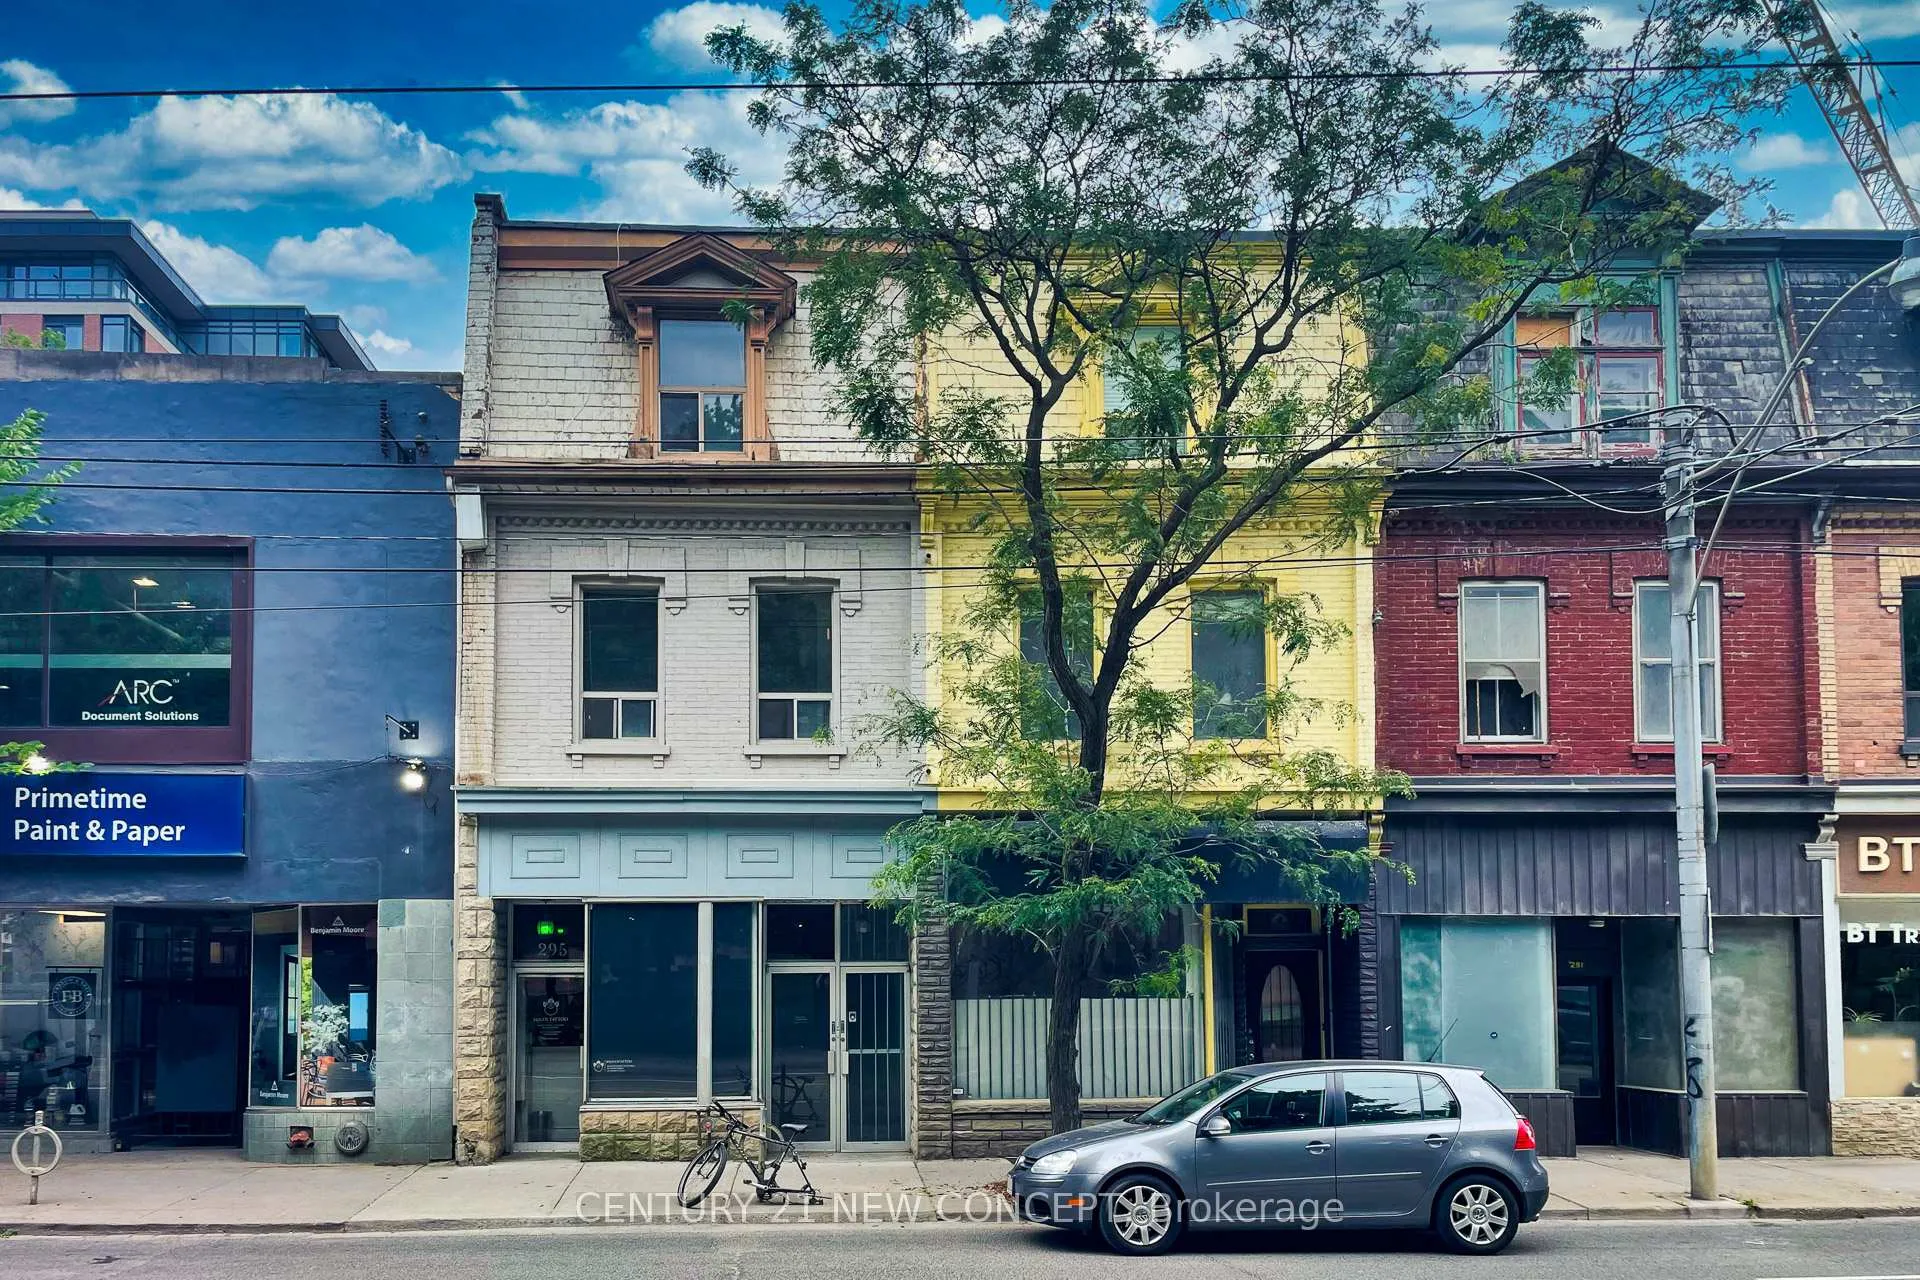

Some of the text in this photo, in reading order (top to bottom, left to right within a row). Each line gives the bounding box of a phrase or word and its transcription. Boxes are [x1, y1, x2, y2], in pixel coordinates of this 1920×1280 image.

[109, 680, 172, 704] ARC
[81, 711, 199, 721] Document Solutions
[15, 787, 146, 809] Primetime
[15, 819, 186, 847] Paint & Paper
[1858, 836, 1920, 872] BT
[310, 925, 365, 935] Benjamin Moore
[1848, 923, 1879, 944] BT
[538, 943, 567, 956] 295
